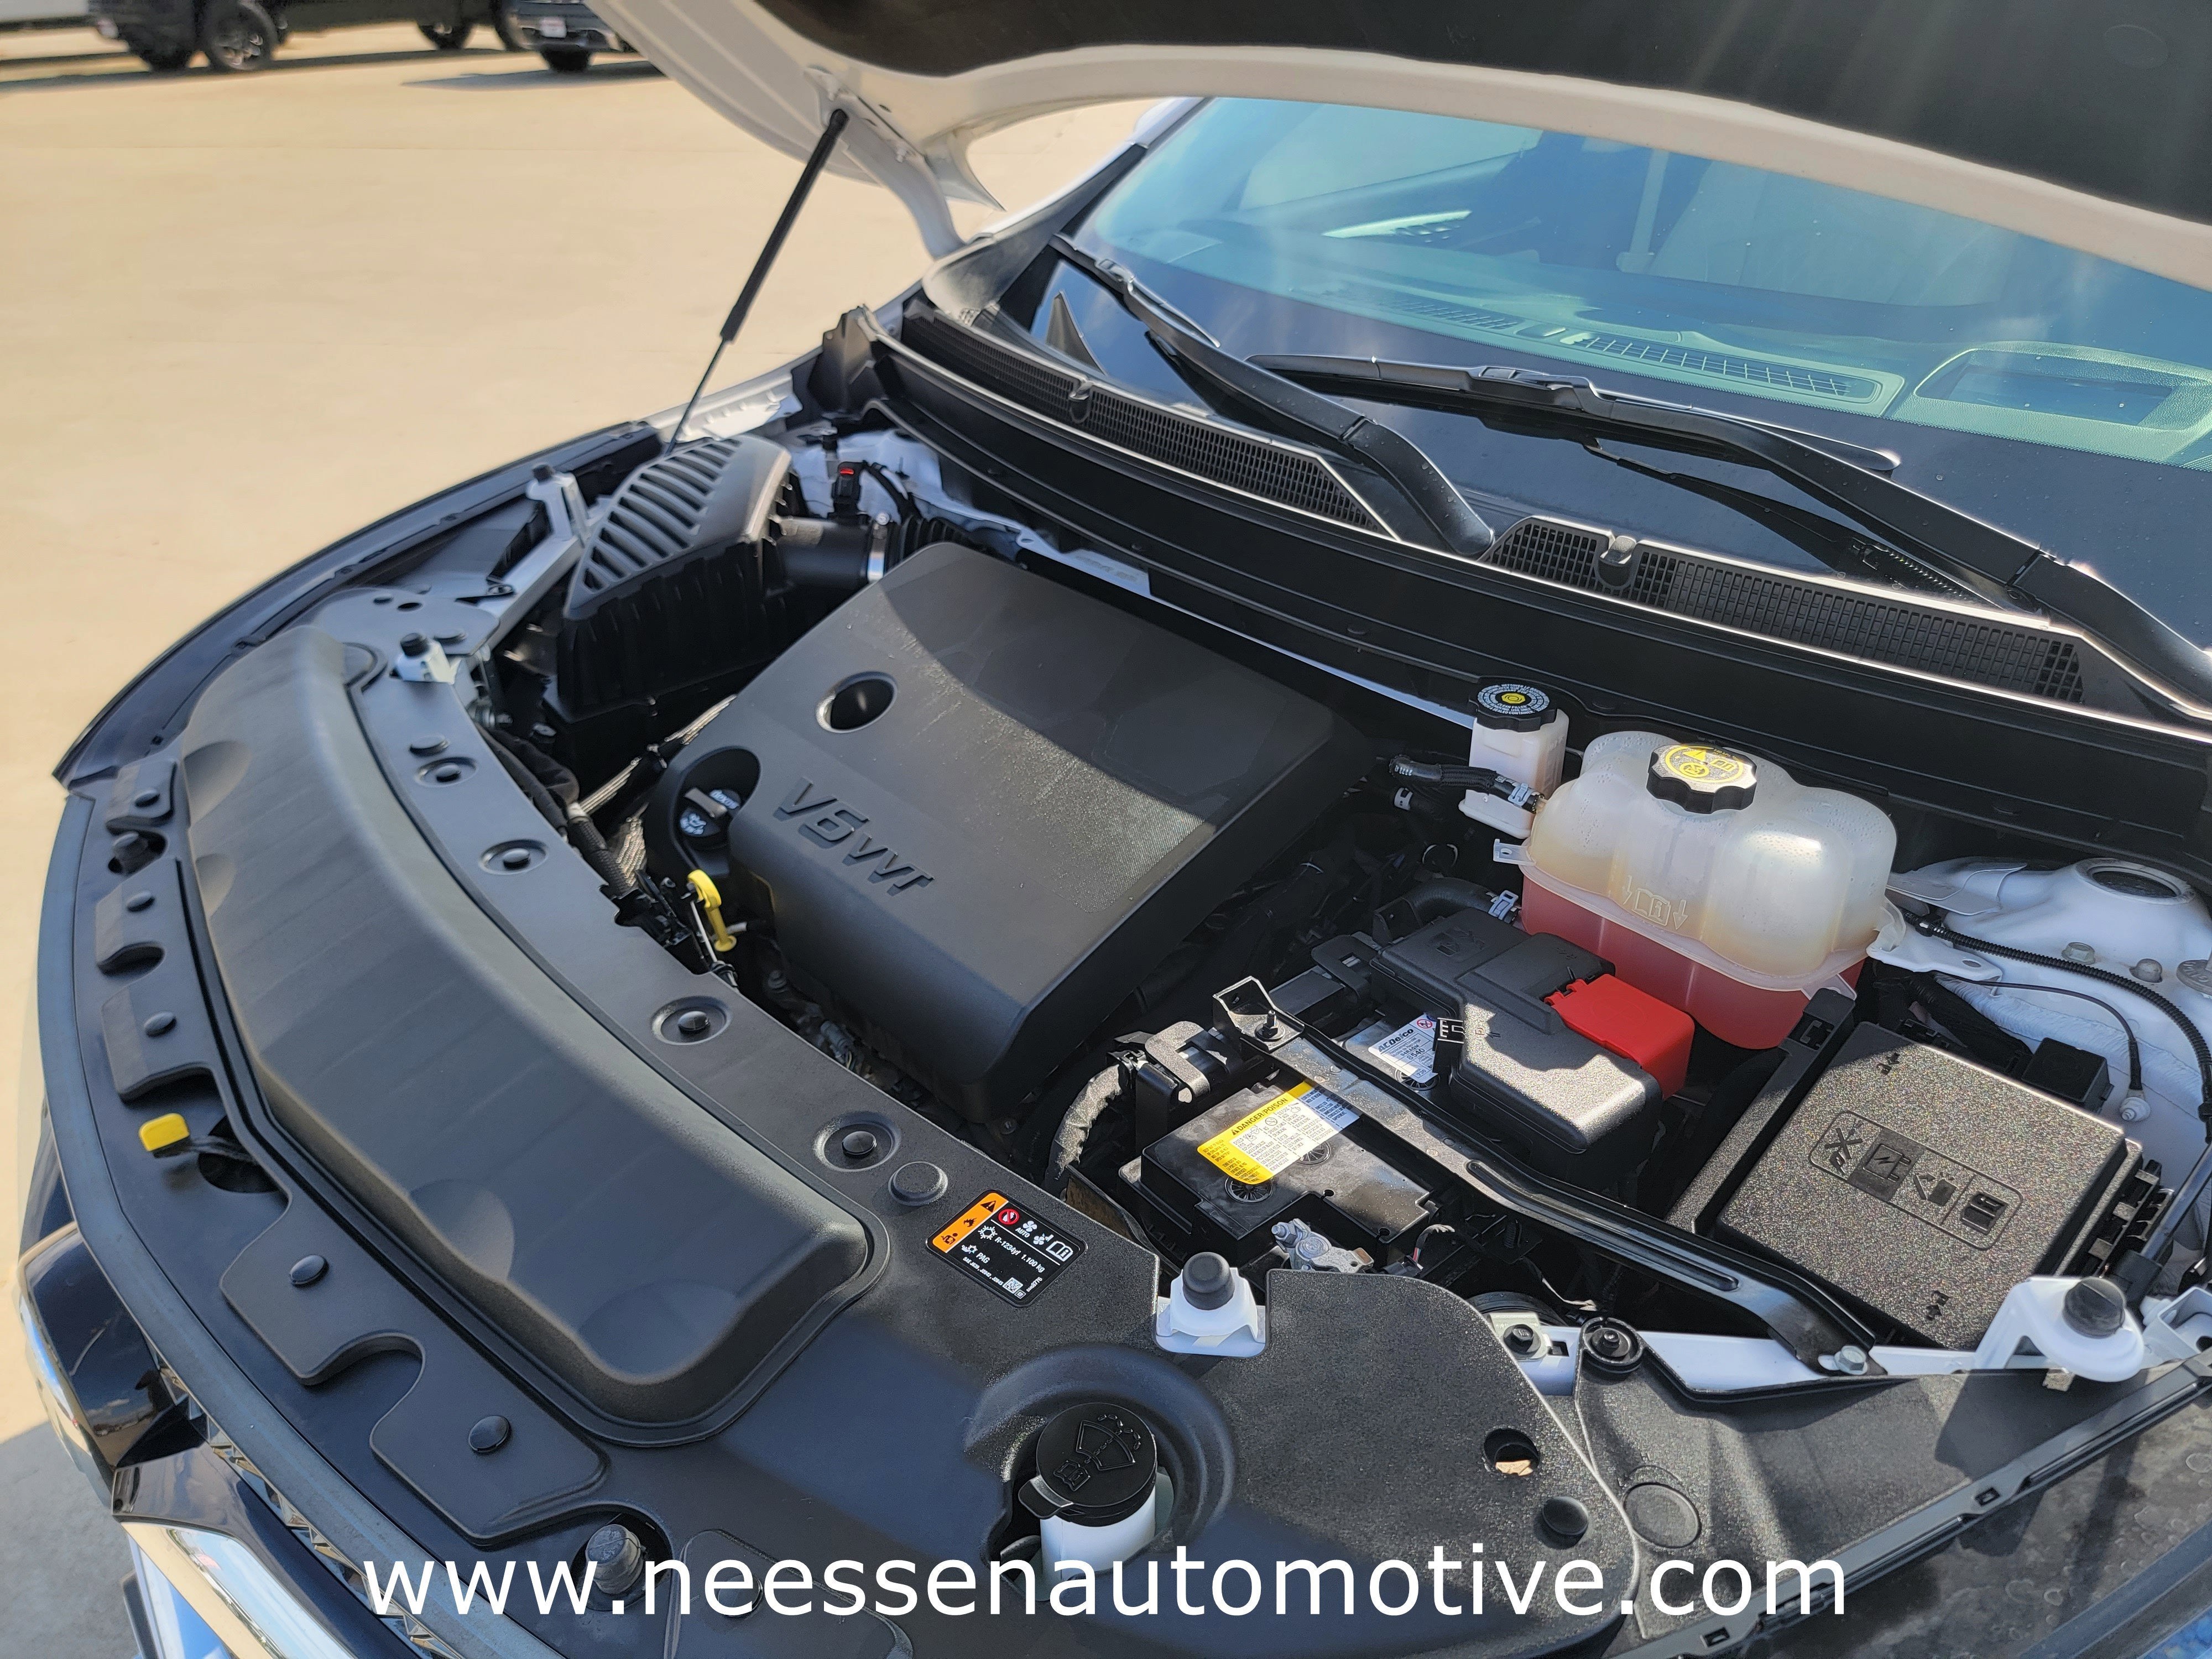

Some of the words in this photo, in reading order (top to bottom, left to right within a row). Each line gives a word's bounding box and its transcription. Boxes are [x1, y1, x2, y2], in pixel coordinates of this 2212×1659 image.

[774, 776, 870, 848] V6
[842, 833, 935, 896] VVT
[1378, 1029, 1414, 1052] ACDelco
[1407, 1048, 1426, 1060] 8540
[1237, 1098, 1288, 1131] DANGER/POISON
[1015, 1227, 1031, 1238] AUTO
[975, 1252, 990, 1264] PAG
[994, 1237, 1022, 1256] R-1234yf
[1021, 1254, 1038, 1267] 1.100
[1036, 1264, 1045, 1273] kg
